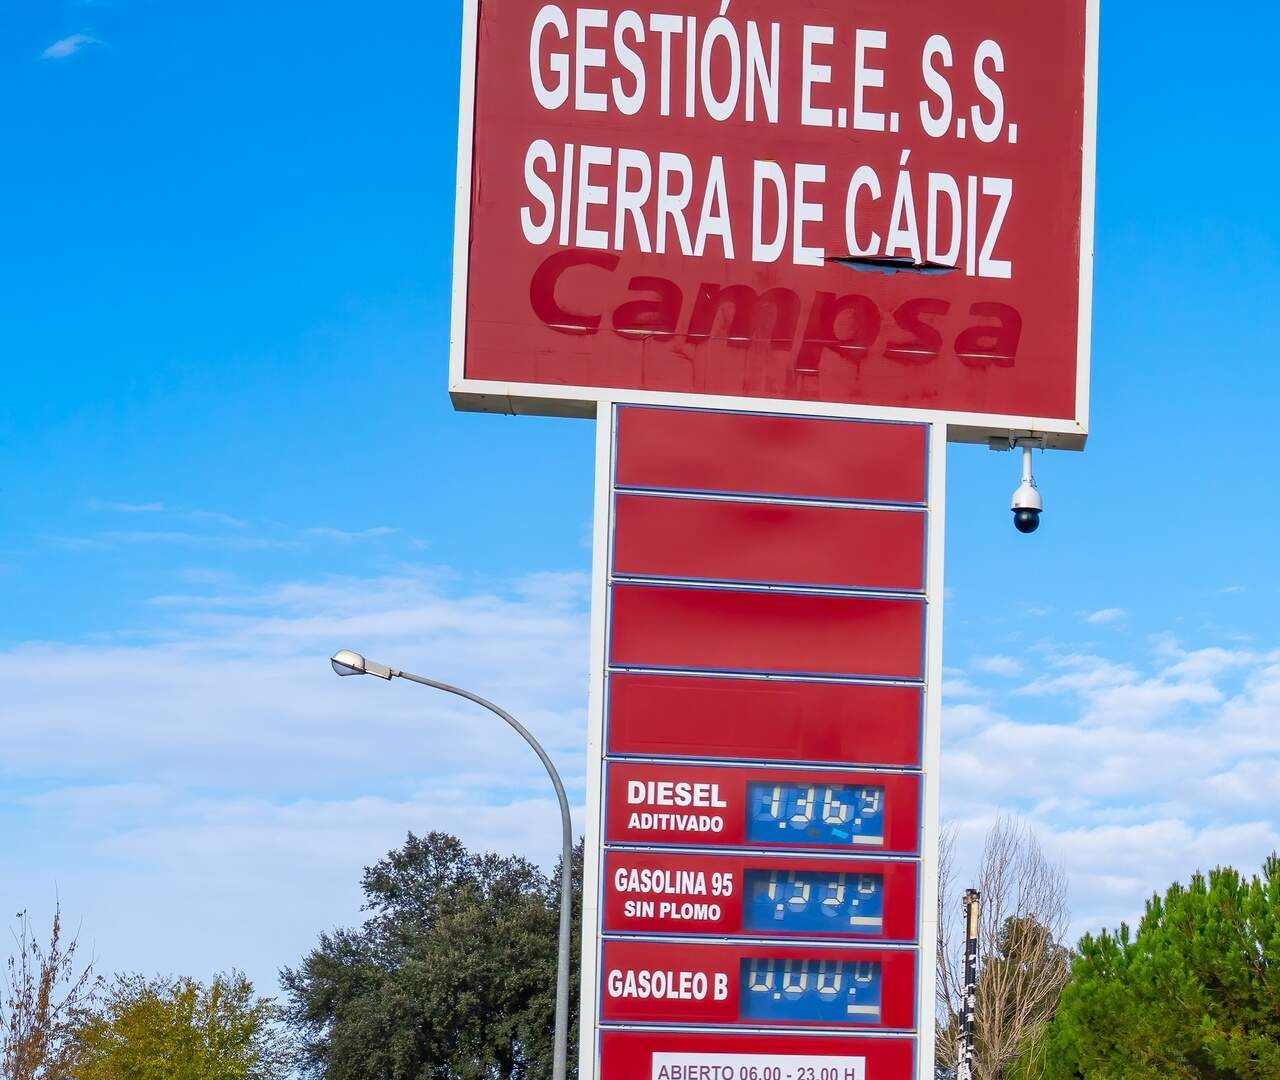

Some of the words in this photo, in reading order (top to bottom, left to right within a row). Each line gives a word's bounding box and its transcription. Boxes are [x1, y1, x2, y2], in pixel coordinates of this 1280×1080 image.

[529, 0, 780, 124] GESTIÓN
[800, 24, 900, 133] E.E.
[919, 34, 1018, 144] S.S.
[520, 139, 735, 260] SIERRA
[751, 159, 826, 267] DE
[845, 149, 1014, 279] CÁDIZ
[529, 248, 1023, 374] Campsa
[627, 780, 727, 808] DIESEL
[627, 812, 724, 833] ADITIVADO
[614, 867, 707, 896] GASOLINA
[711, 872, 733, 897] 95
[624, 900, 655, 918] SIN
[659, 902, 721, 921] PLOMO
[607, 969, 708, 1000] GASOLEO
[713, 972, 728, 1001] B
